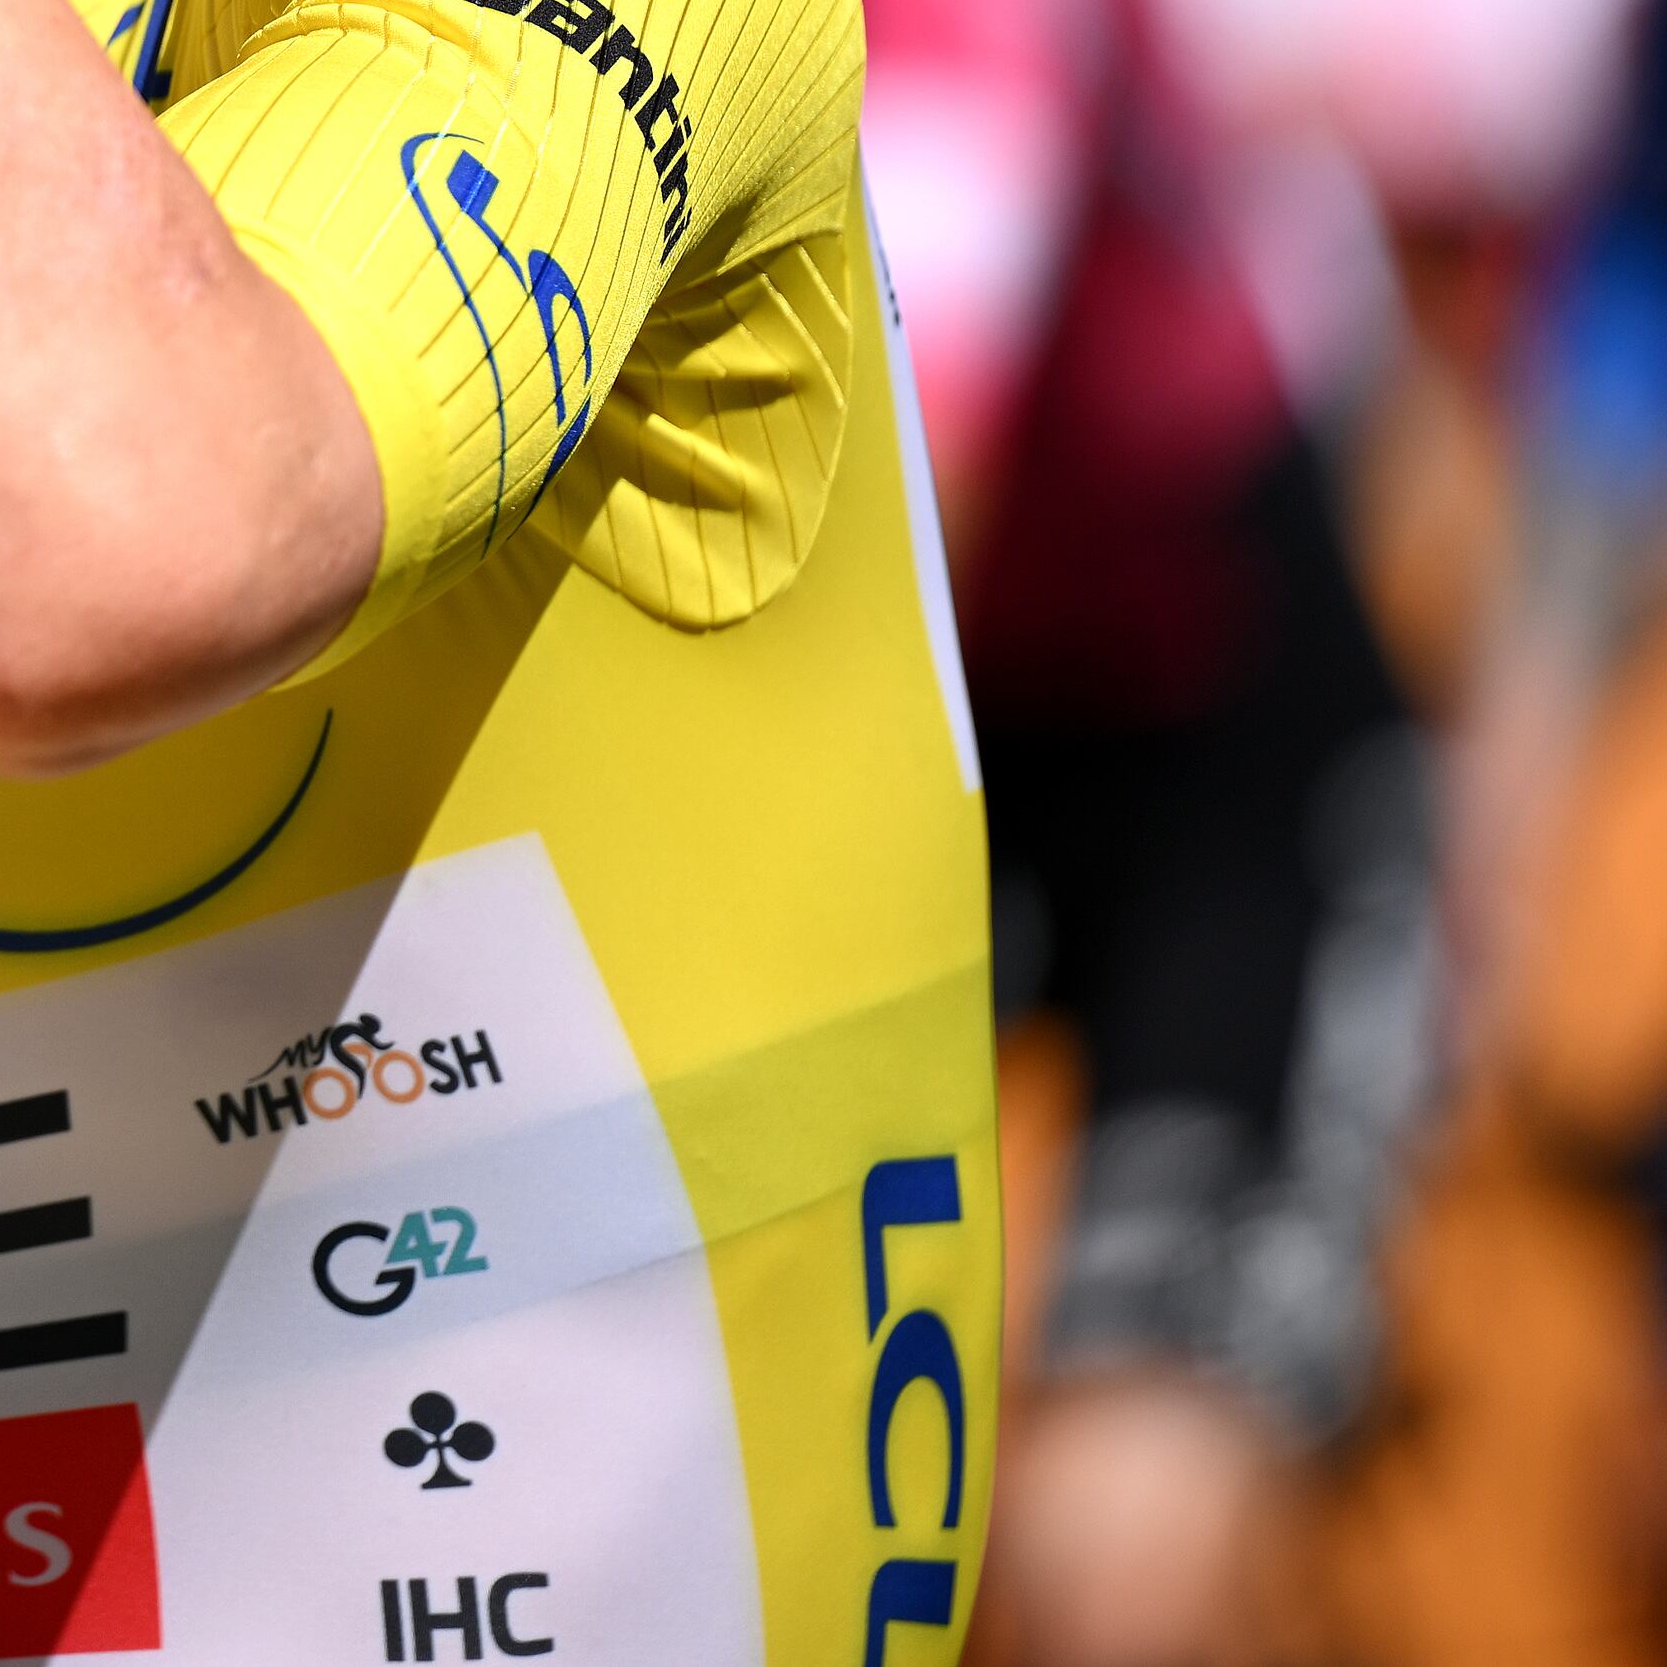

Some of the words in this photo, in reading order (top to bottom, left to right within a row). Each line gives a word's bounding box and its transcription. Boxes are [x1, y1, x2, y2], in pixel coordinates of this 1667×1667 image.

[194, 1030, 504, 1144] WHOOSH
[312, 1205, 490, 1317] G42
[380, 1570, 555, 1663] IHC
